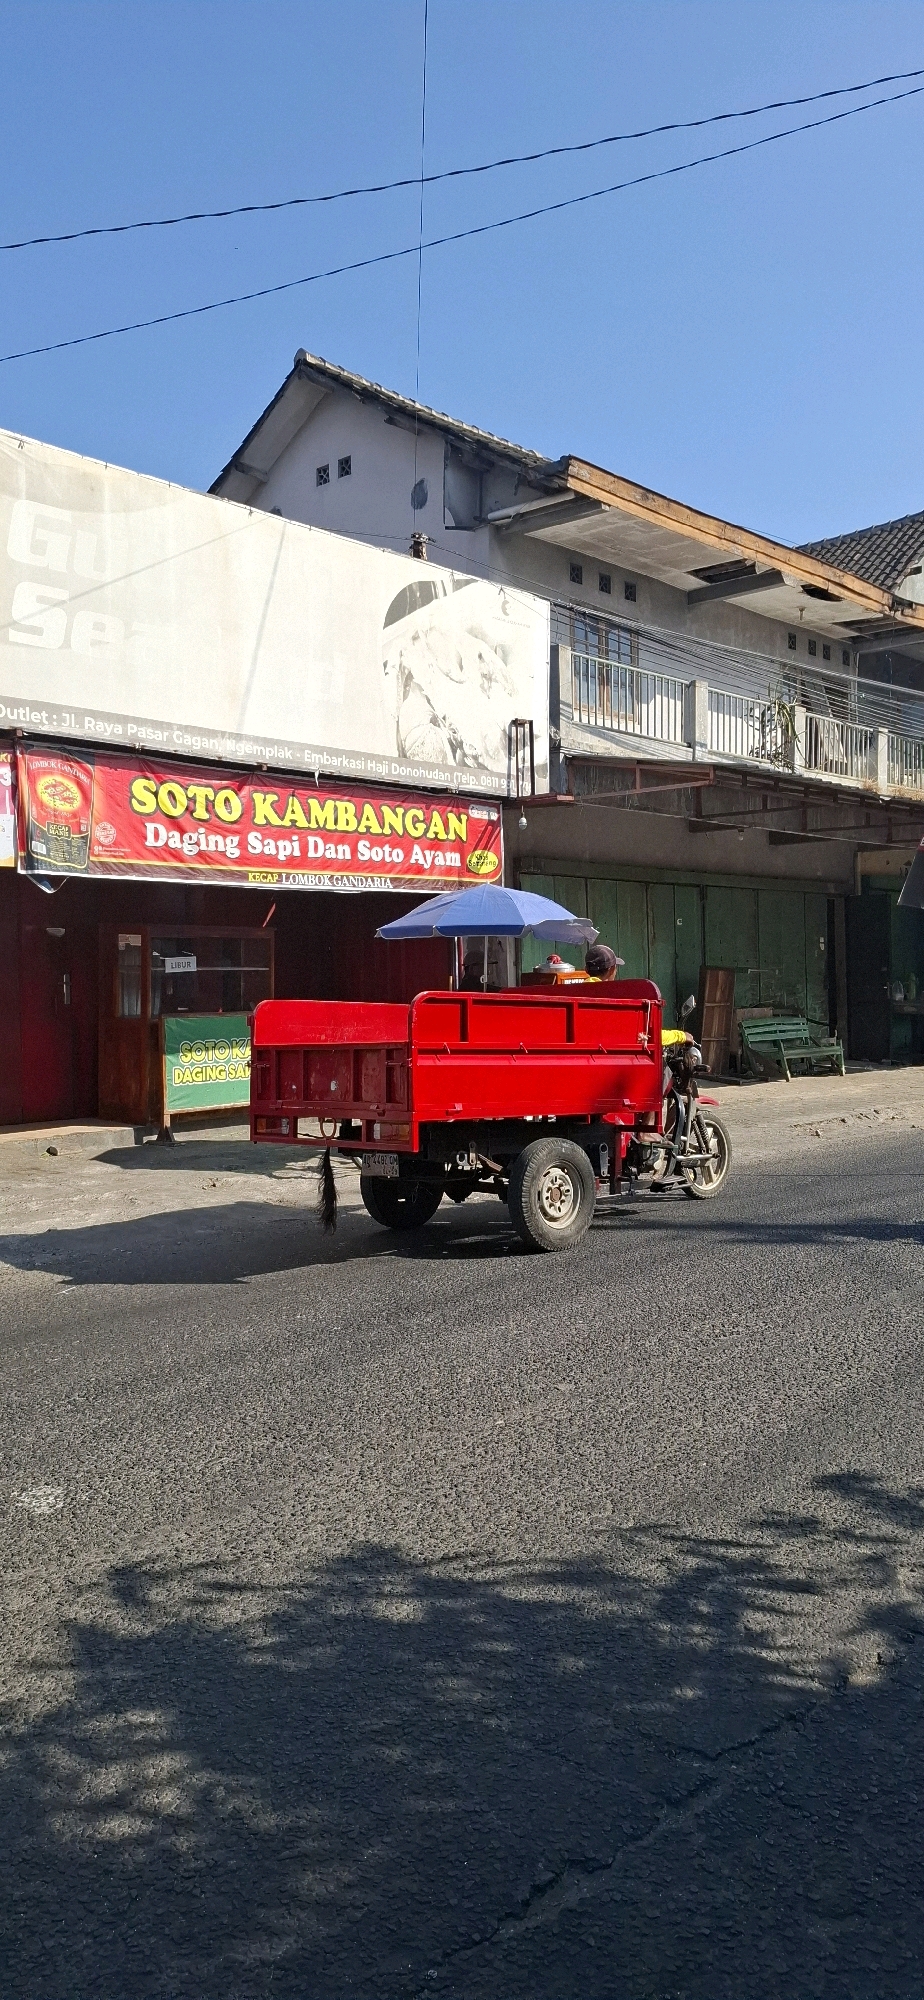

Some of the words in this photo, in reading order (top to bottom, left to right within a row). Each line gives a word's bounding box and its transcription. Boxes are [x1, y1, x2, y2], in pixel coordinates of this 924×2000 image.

[0, 703, 49, 725] Outlet
[62, 713, 79, 729] Jl.
[84, 717, 123, 736] Raya
[127, 723, 170, 742] Pasar
[172, 731, 222, 752] Gagan,
[226, 738, 293, 760] Ngemplak
[304, 749, 365, 770] Embarkasi
[367, 759, 389, 776] Haji
[391, 763, 451, 781] Donohudan
[453, 771, 479, 787] (Telp.
[481, 775, 499, 788] 0811
[130, 777, 244, 823] SOTO
[251, 790, 468, 843] KAMBANGAN
[144, 822, 241, 859] Daging
[247, 831, 301, 861] Sapi
[307, 835, 352, 860] Dan
[357, 840, 404, 863] Soto
[409, 844, 461, 869] Ayam
[248, 872, 279, 883] KECAP
[281, 873, 333, 886] LOMBOK
[333, 875, 394, 889] GANDARIA
[171, 961, 192, 969] LIBUR
[180, 1040, 231, 1064] SOTO
[173, 1064, 228, 1086] DAGING
